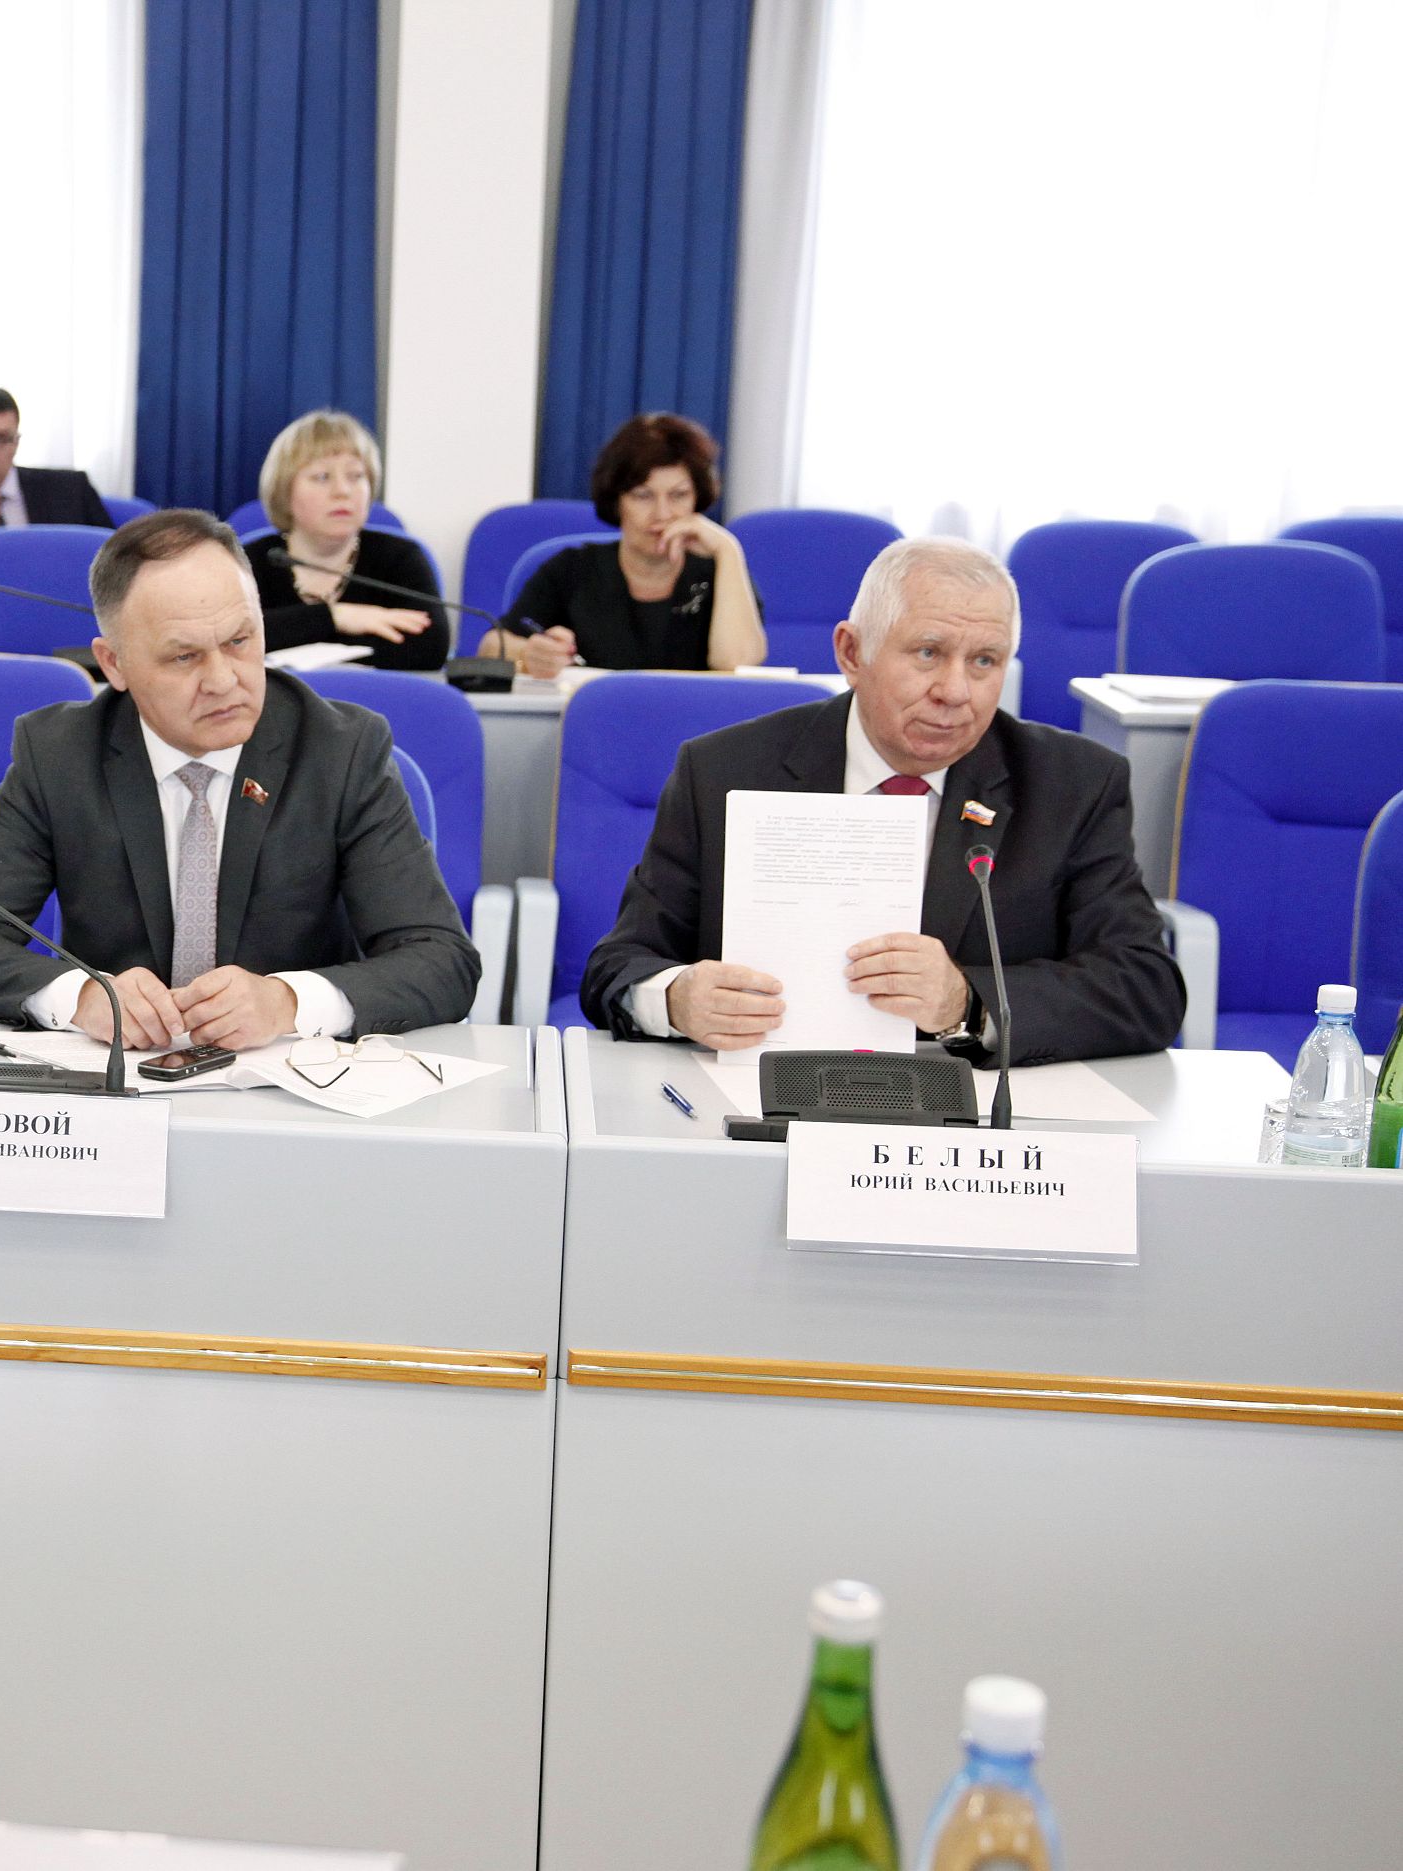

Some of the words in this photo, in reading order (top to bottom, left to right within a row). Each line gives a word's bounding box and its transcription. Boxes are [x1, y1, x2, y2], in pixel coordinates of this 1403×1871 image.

[872, 1144, 1044, 1171] БЕЛЫЙ
[850, 1172, 914, 1190] ЮРИЙ
[925, 1177, 1065, 1197] ВАСИЛЬЕВИЧ
